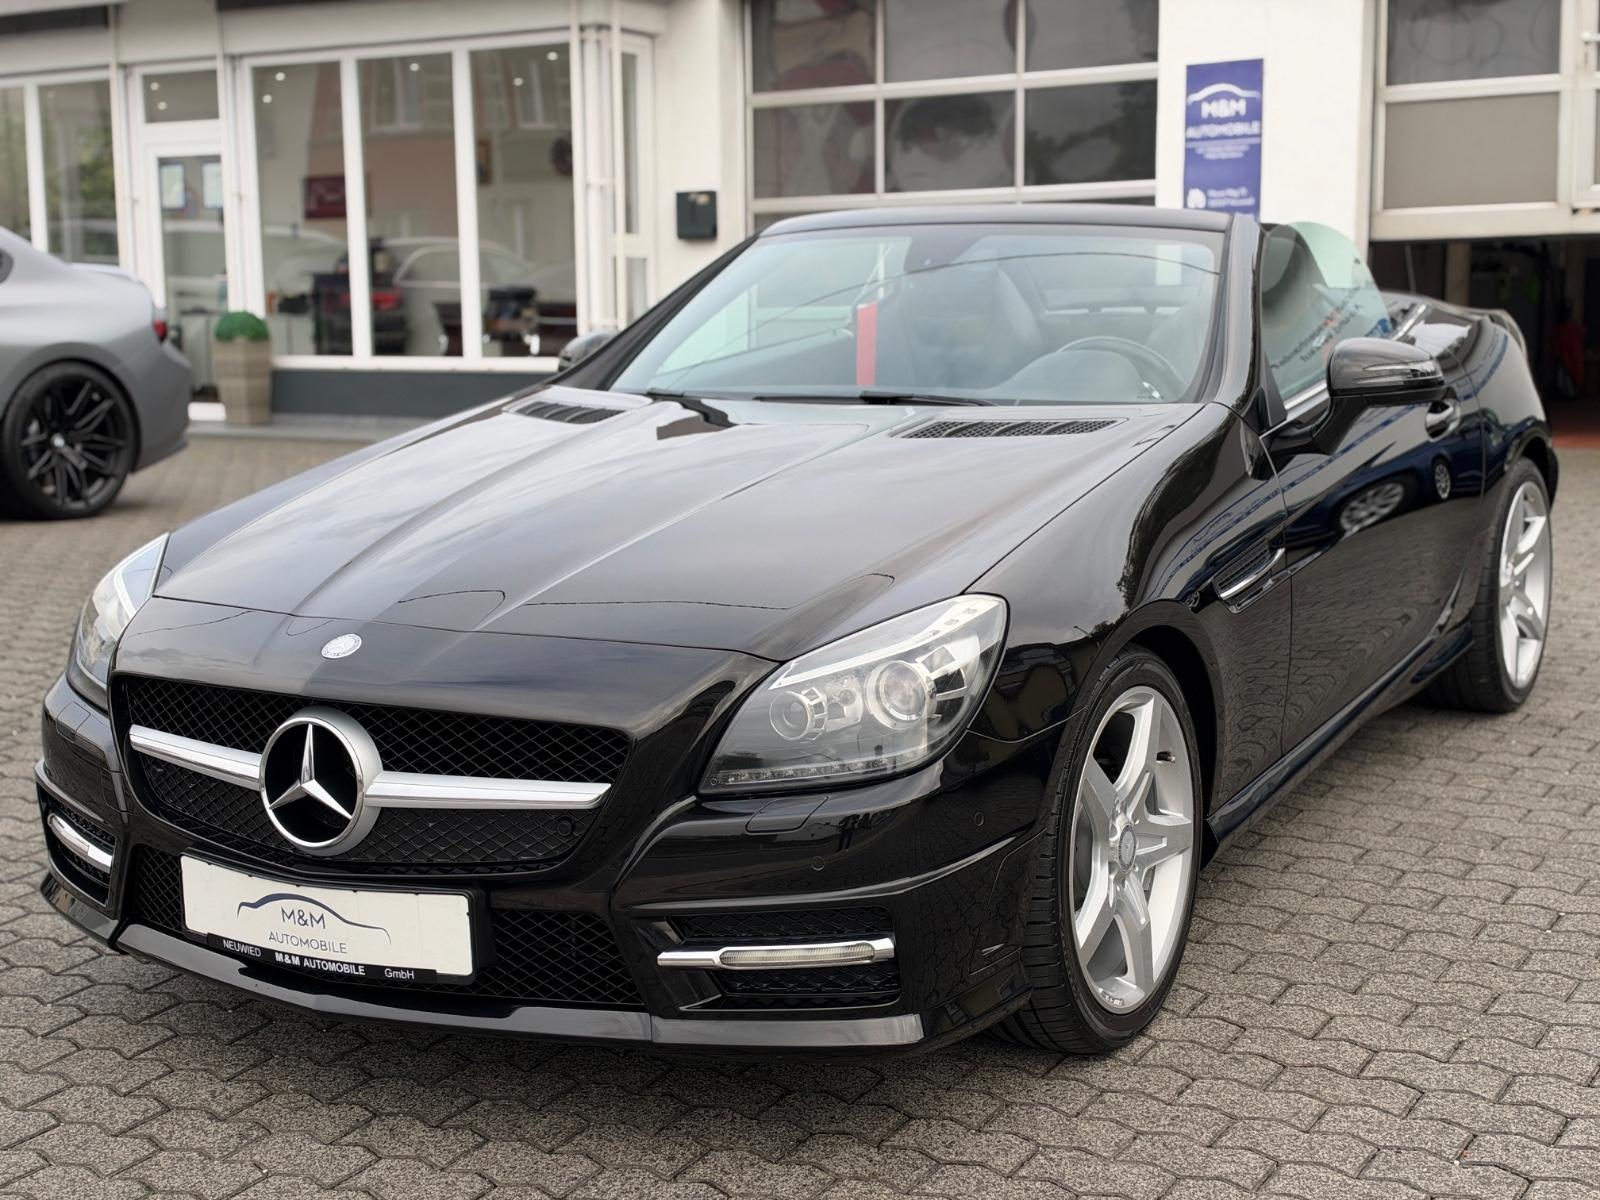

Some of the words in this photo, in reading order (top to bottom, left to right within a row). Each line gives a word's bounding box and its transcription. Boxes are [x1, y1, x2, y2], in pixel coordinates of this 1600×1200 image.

[1201, 98, 1247, 119] M&M
[281, 906, 326, 929] M&M
[268, 931, 348, 954] AUTOMOBILE
[222, 939, 262, 958] NEUWIED
[275, 951, 301, 966] M&M
[303, 957, 366, 976] AUTOMOBILE
[384, 968, 415, 980] GmbH
